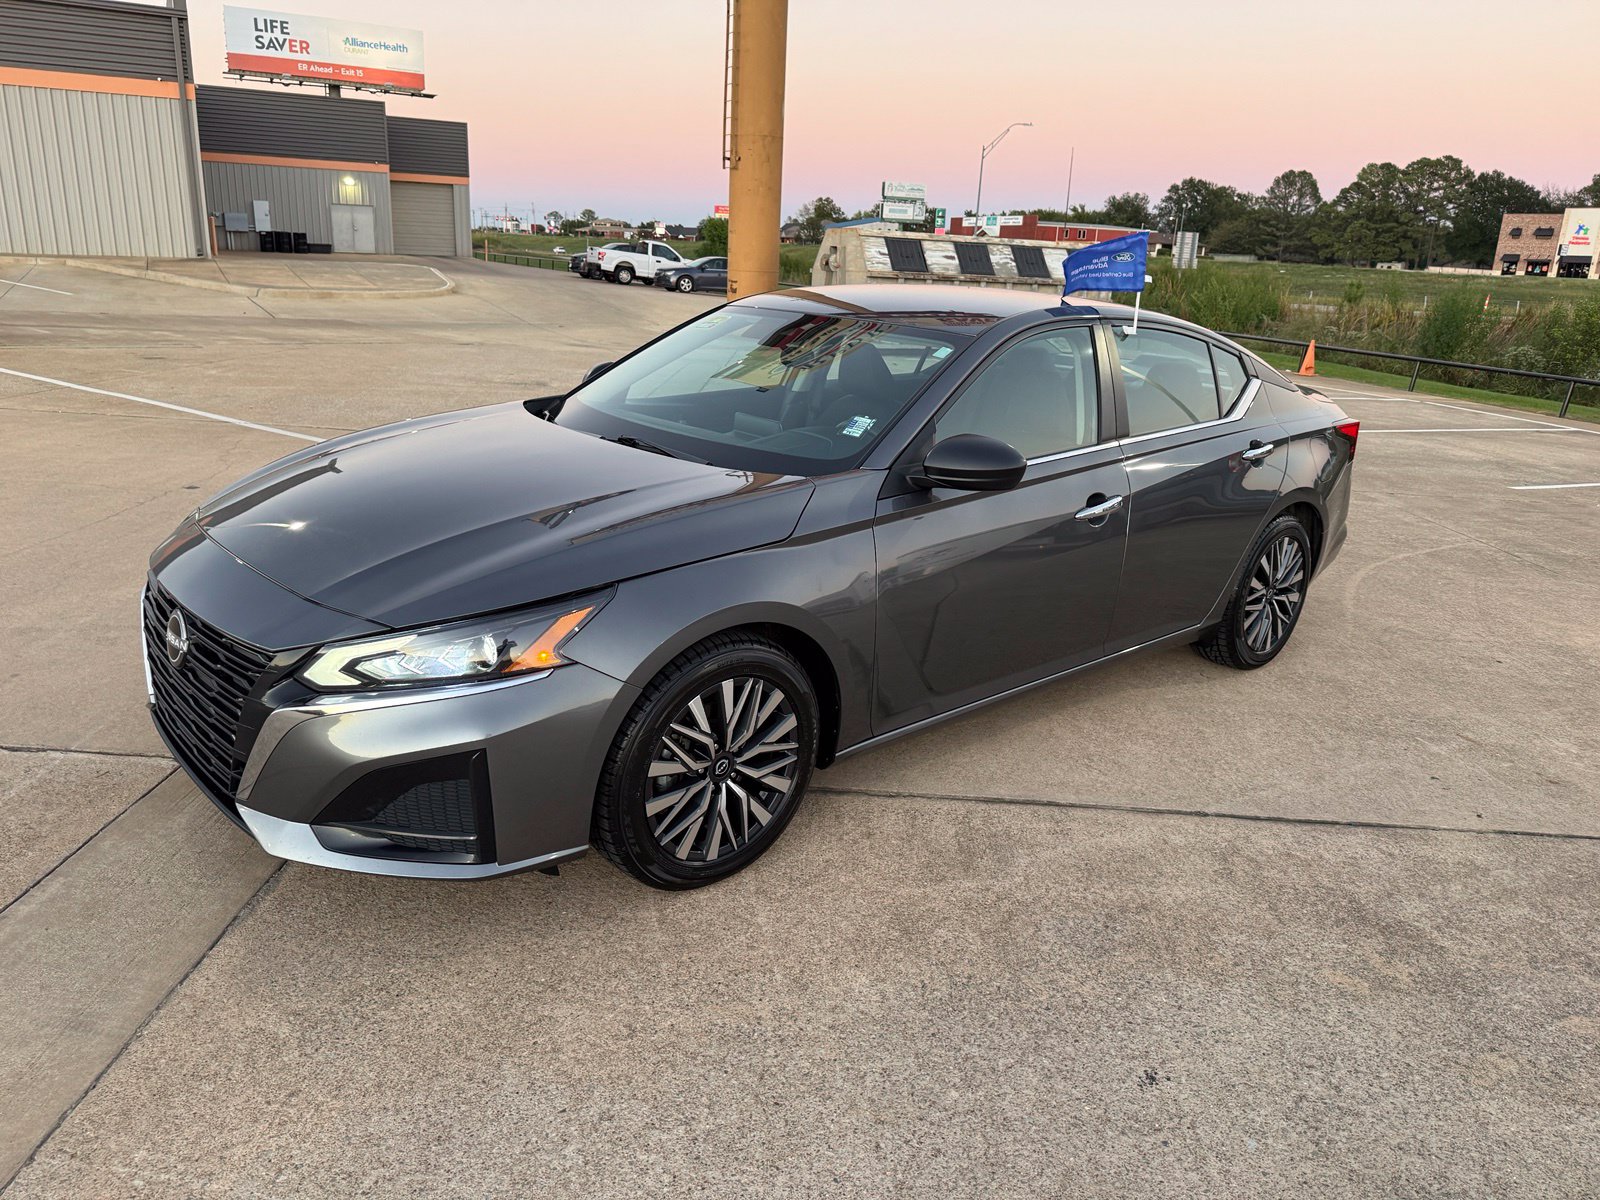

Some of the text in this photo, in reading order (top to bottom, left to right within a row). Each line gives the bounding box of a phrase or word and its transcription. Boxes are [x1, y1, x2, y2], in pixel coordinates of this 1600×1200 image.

[253, 17, 290, 36] LIFE
[255, 35, 311, 55] SAVER
[343, 36, 409, 54] AllianceHealth
[297, 63, 309, 71] ER
[309, 64, 333, 74] Ahead
[341, 67, 355, 76] Exit
[355, 69, 364, 77] 15
[166, 633, 189, 652] NISSAN
